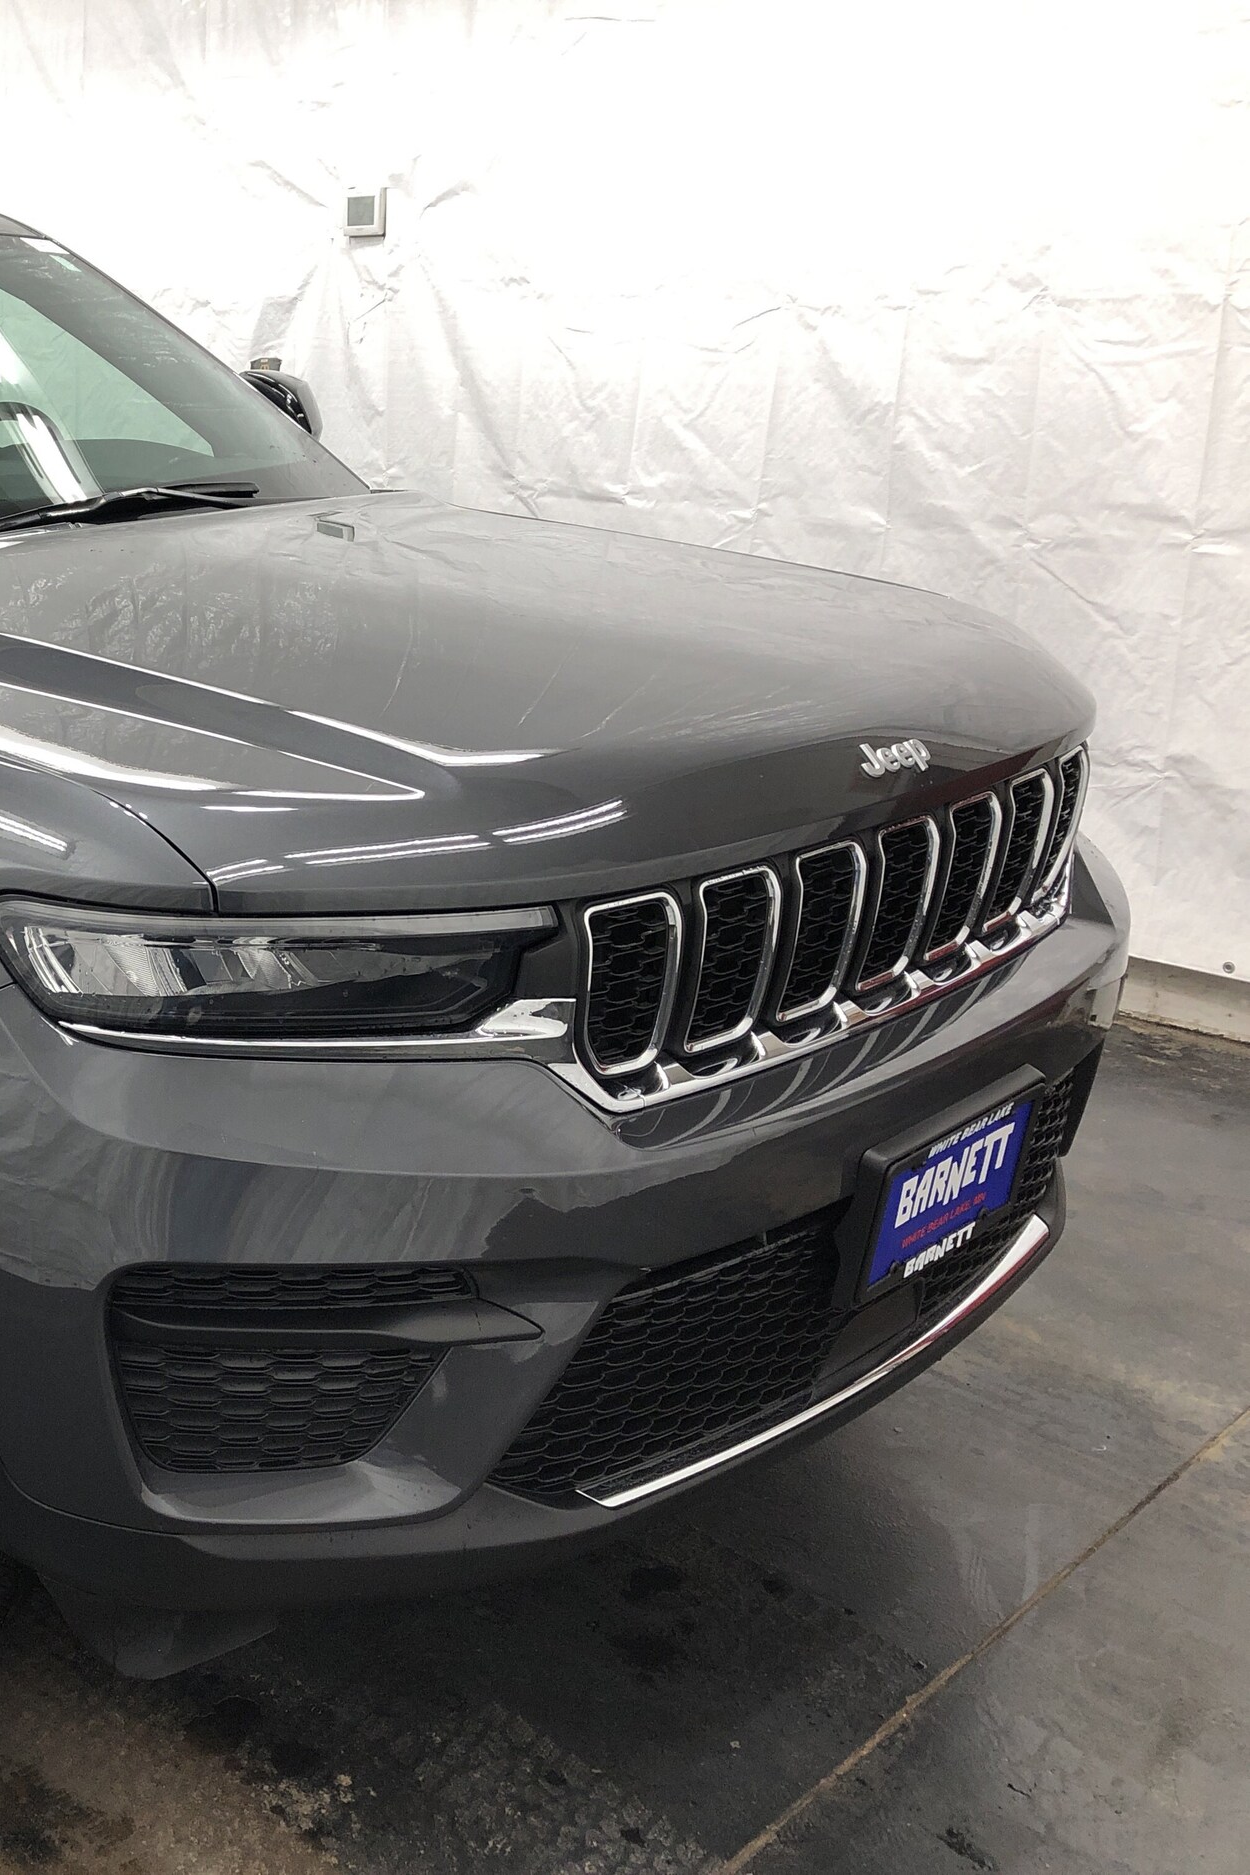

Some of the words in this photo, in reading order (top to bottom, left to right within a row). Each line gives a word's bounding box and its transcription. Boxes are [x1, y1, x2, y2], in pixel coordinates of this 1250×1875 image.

[859, 739, 931, 777] Jeep
[928, 1131, 962, 1158] WHITE
[960, 1117, 988, 1141] BEAR
[986, 1101, 1014, 1126] LAKE
[894, 1122, 1016, 1229] BARNETT
[901, 1226, 927, 1249] WHITE
[926, 1212, 949, 1233] BEAR
[903, 1221, 976, 1279] BARNETT
